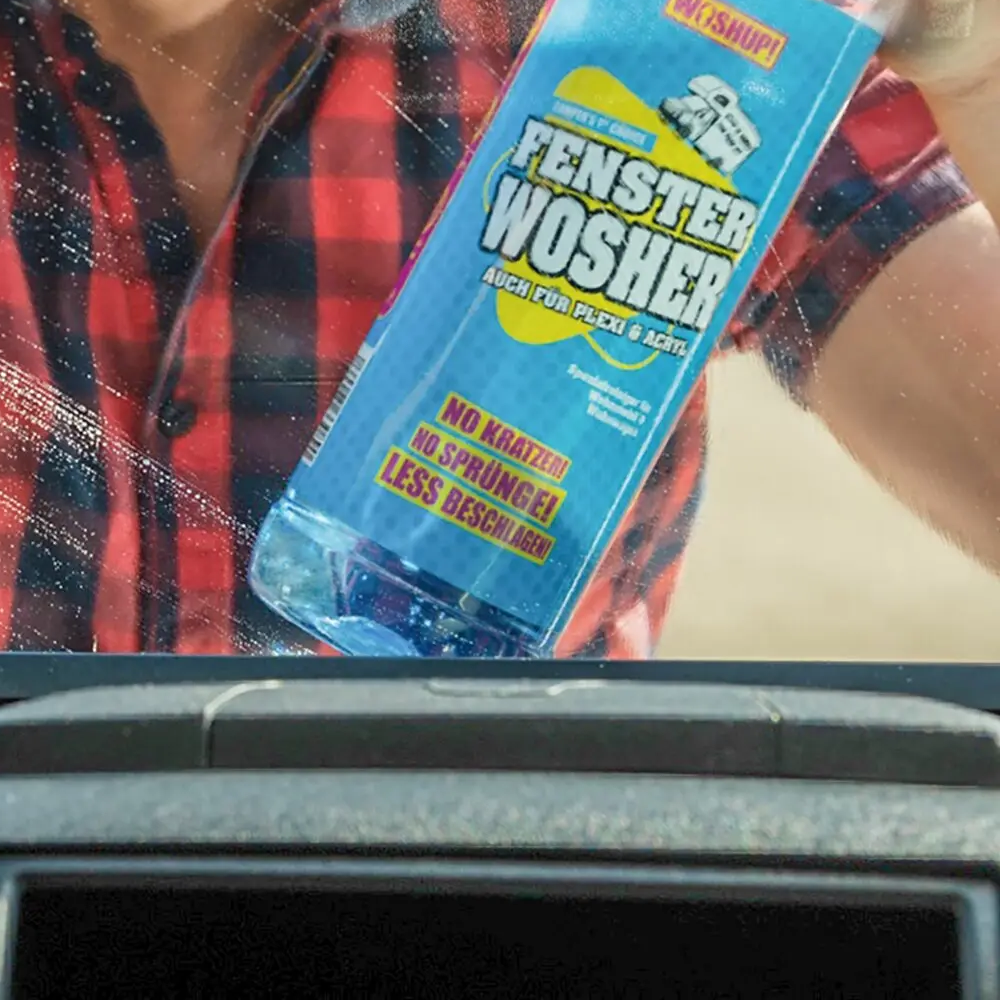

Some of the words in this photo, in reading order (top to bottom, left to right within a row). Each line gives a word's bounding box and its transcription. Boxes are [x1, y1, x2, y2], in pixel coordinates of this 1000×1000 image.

[510, 115, 758, 253] FENSTER
[479, 171, 735, 333] WOSHER
[481, 266, 533, 299] AUCH
[532, 285, 572, 314] FÜR
[572, 301, 627, 337] PLEXI
[410, 426, 441, 457] NO
[438, 442, 560, 524] SPRÜNGE!
[441, 396, 482, 434] NO
[479, 419, 570, 480] KRATZER!
[380, 452, 444, 506] LESS
[440, 486, 553, 561] BESCHLAGEN!
